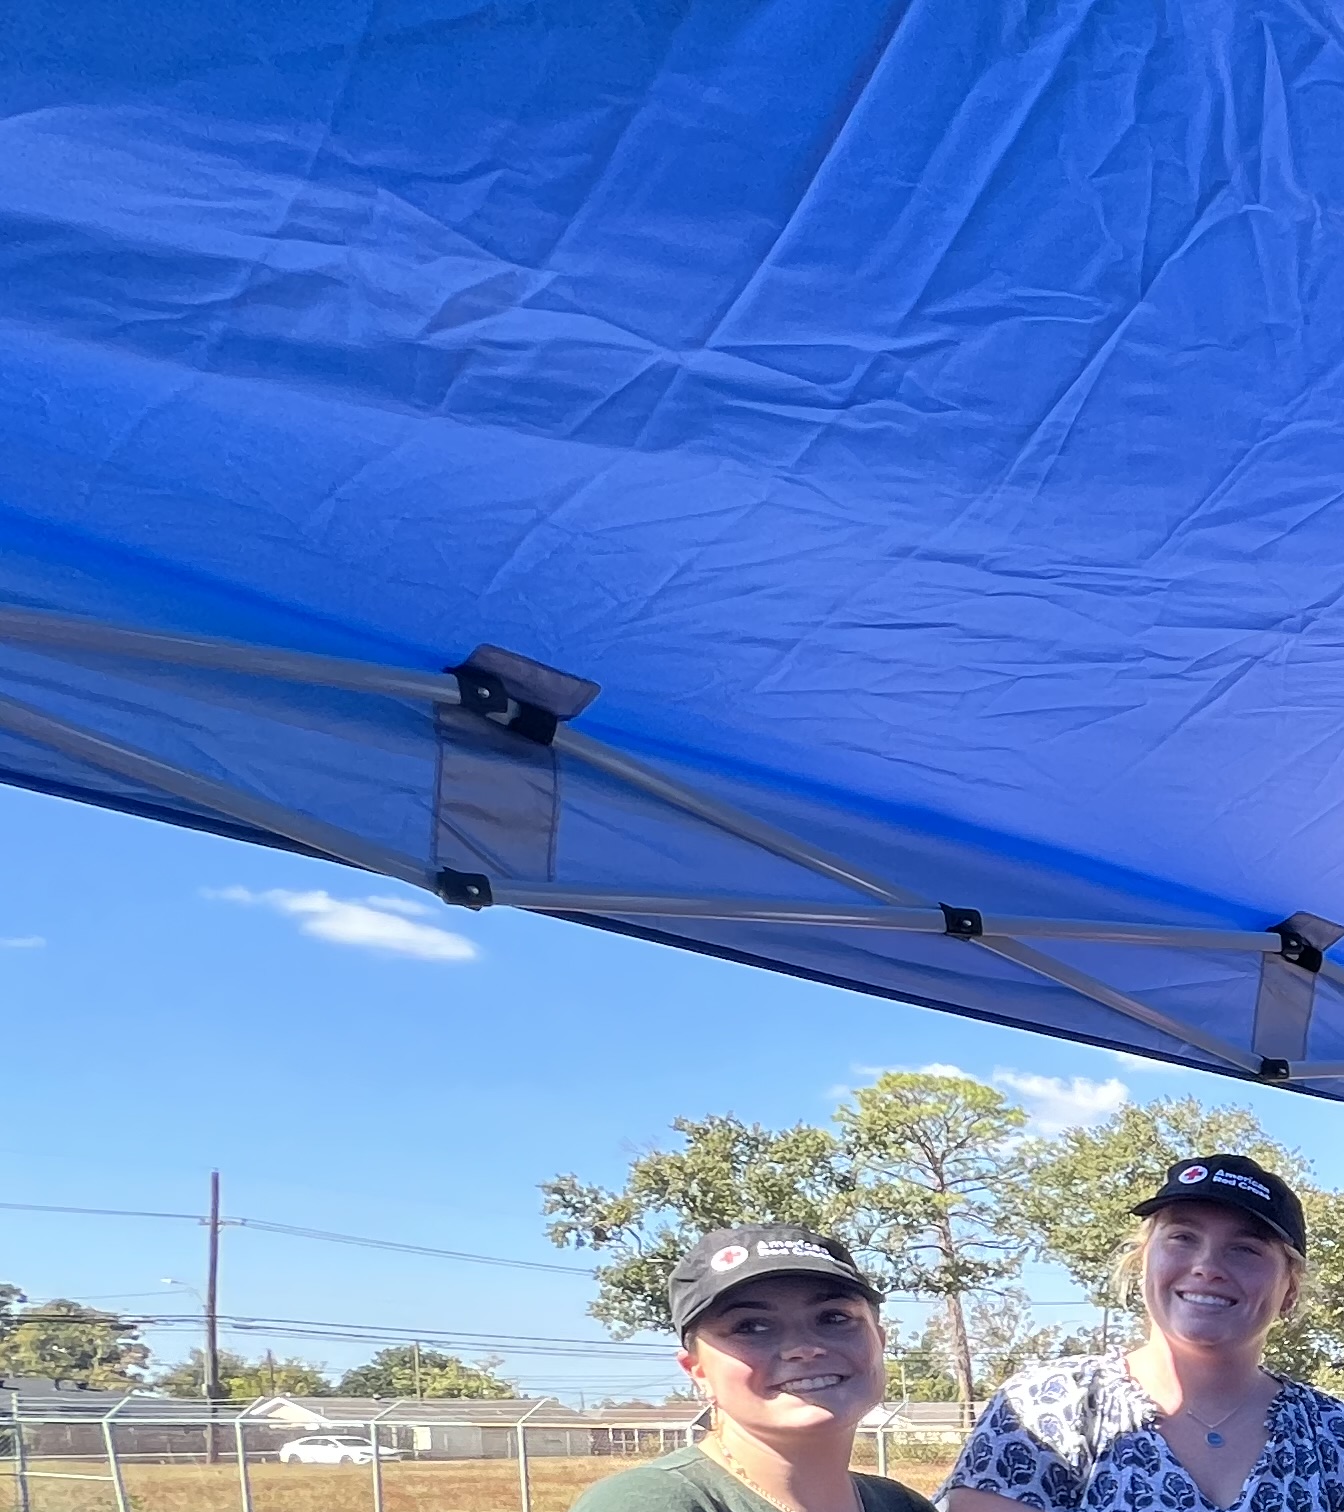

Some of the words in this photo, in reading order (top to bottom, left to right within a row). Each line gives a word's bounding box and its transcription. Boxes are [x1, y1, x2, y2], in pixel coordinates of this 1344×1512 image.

[1212, 1174, 1237, 1187] Red
[1237, 1181, 1272, 1201] Cross
[1214, 1169, 1271, 1193] American
[757, 1239, 830, 1257] American
